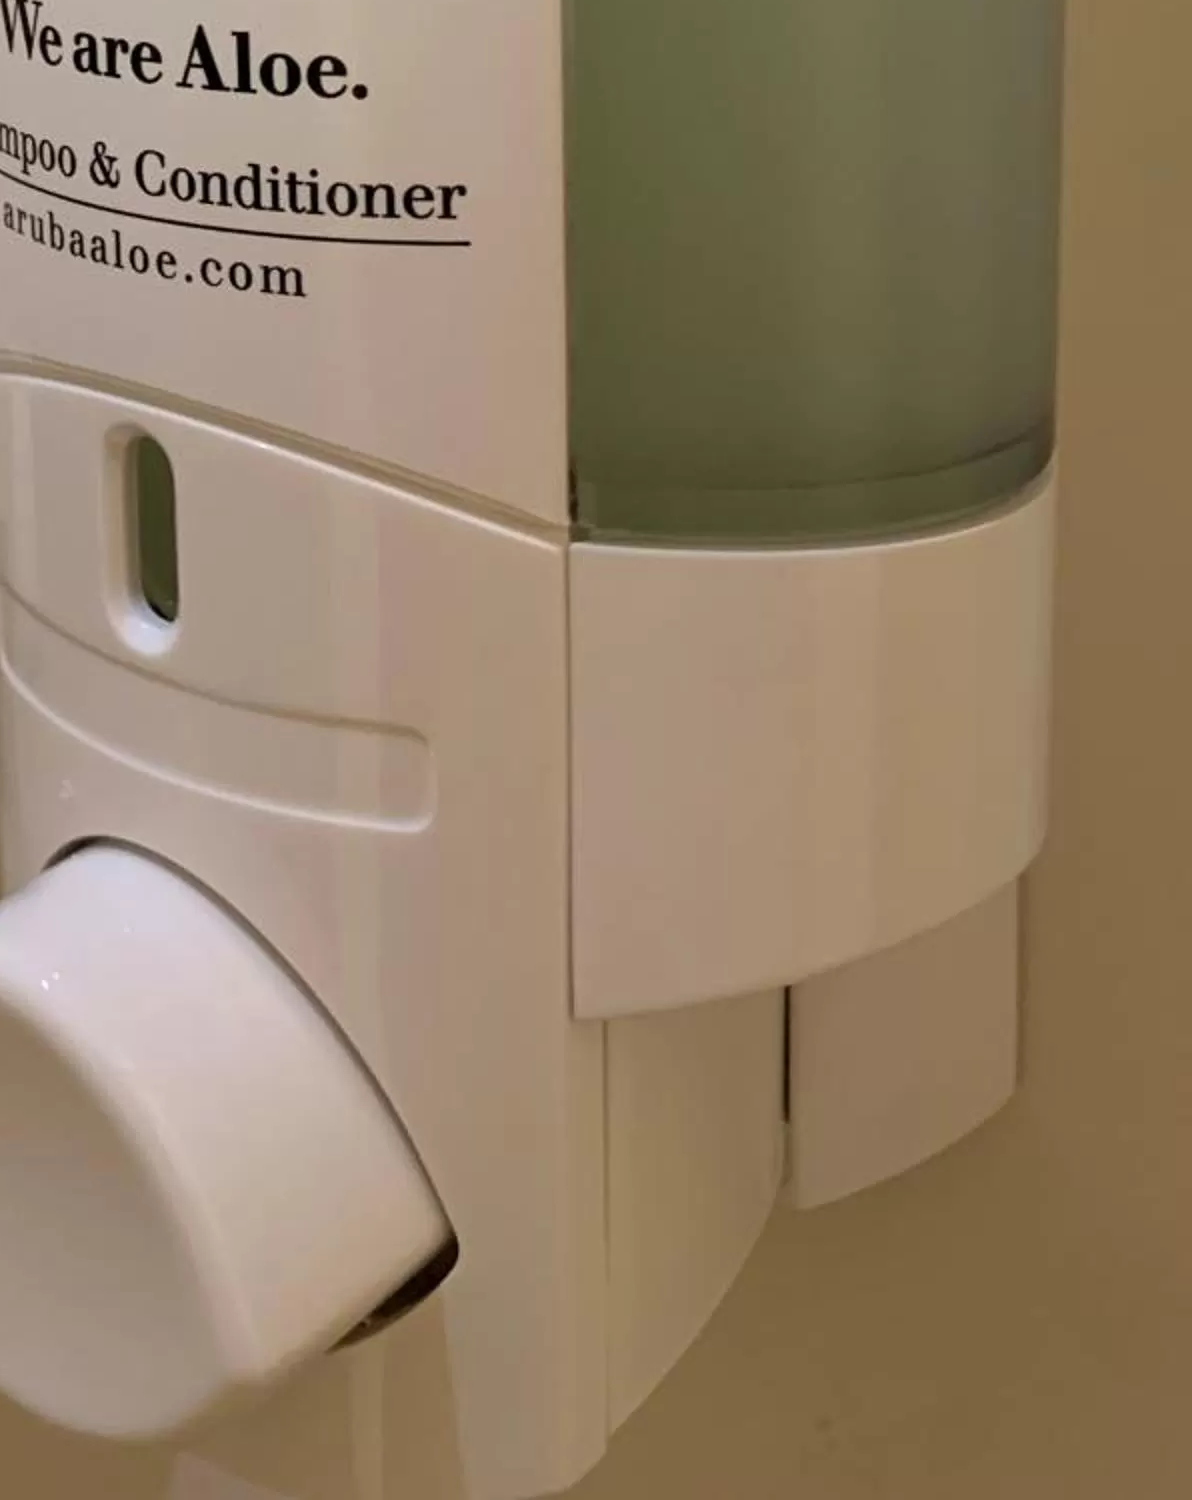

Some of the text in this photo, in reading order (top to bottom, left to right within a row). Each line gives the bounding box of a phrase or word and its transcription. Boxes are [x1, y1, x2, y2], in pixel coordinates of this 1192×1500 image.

[72, 27, 164, 85] are
[175, 23, 369, 101] Aloe.
[89, 140, 121, 190] &
[135, 148, 468, 221] Conditioner
[2, 201, 308, 299] arubaaloe.com
